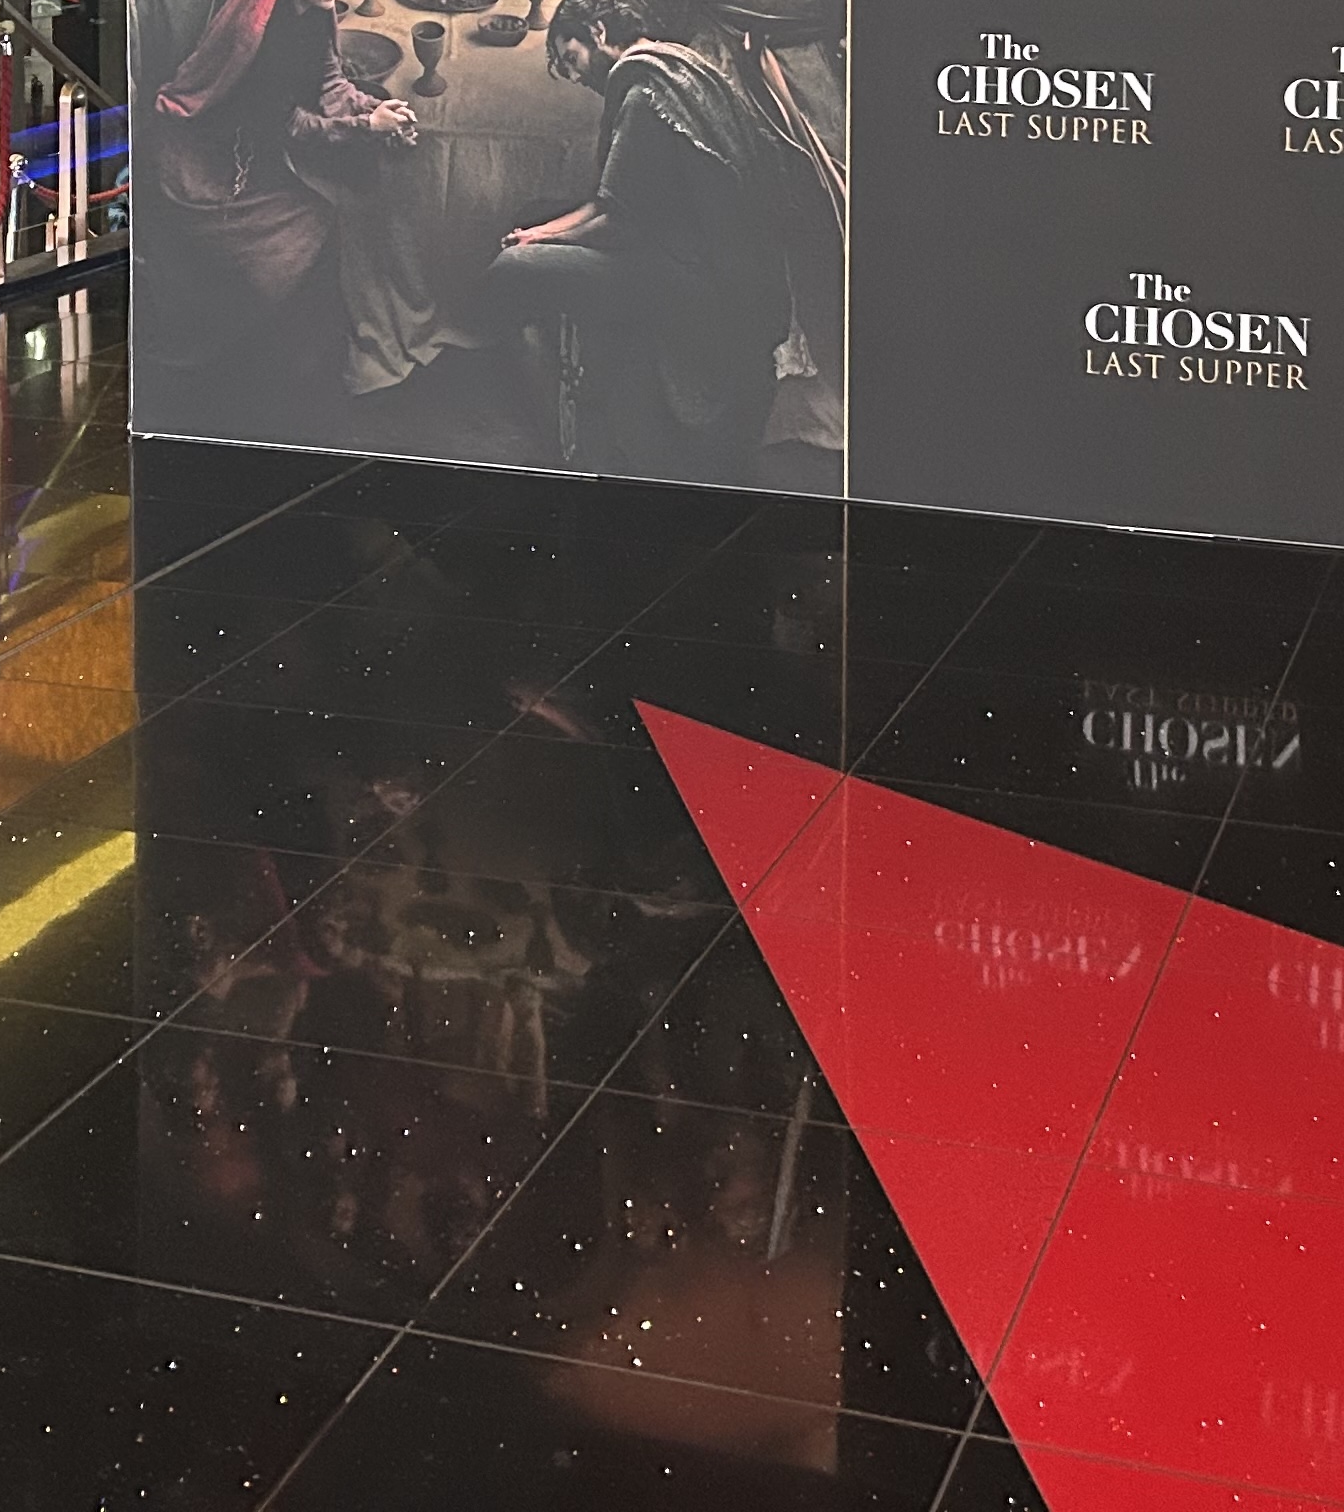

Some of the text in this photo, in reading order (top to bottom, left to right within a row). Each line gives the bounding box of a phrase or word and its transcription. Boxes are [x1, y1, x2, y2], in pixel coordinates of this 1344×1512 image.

[980, 34, 1039, 60] The
[938, 65, 1154, 111] CHOSEN
[939, 111, 1151, 144] LAST SUPPER
[1130, 273, 1191, 302] The
[1085, 304, 1310, 356] CHOSEN
[1087, 350, 1308, 390] LAST SUPPER
